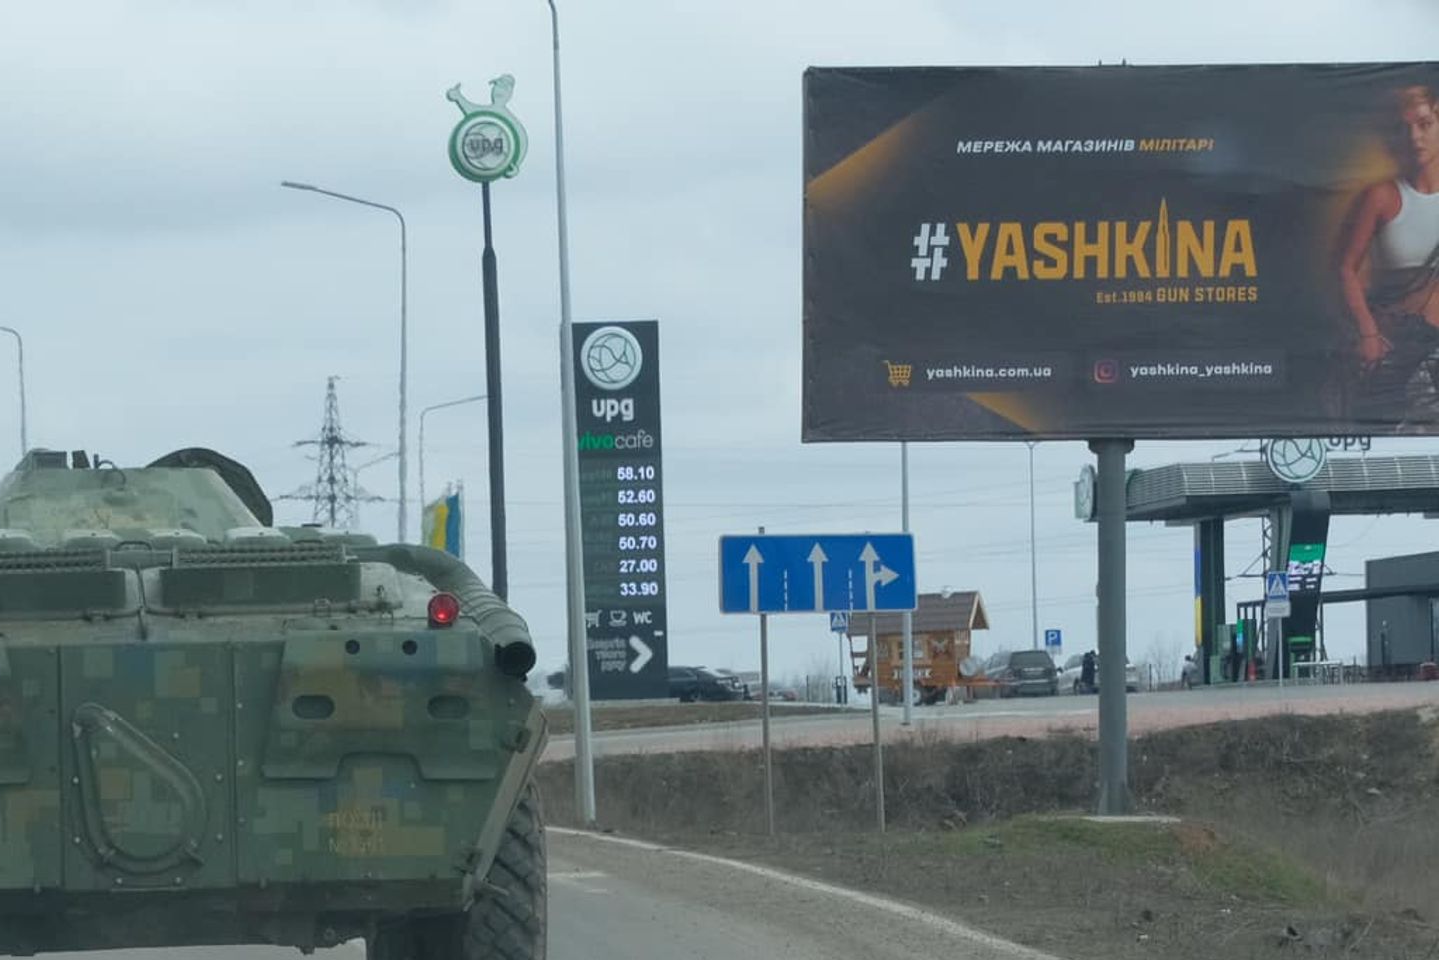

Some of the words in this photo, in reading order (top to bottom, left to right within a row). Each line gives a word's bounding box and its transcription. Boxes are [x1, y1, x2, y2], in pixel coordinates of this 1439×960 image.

[956, 140, 1032, 153] МЕРЕЖА
[1036, 139, 1135, 152] МАГАЗИНІВ
[1138, 138, 1215, 151] МІЛІТАРІ
[911, 197, 1258, 281] #YASHKINA
[1156, 287, 1190, 302] GUN
[1194, 286, 1258, 302] STORES
[926, 365, 1052, 380] yashkina.com.ua
[1130, 362, 1273, 379] yashkina_yashkina
[592, 398, 635, 422] upg
[617, 489, 656, 504] 52.60
[618, 513, 656, 527] 50.60
[619, 536, 657, 550] 50.70
[619, 559, 658, 573] 27.00
[620, 582, 659, 596] 33.90
[632, 610, 653, 625] WC
